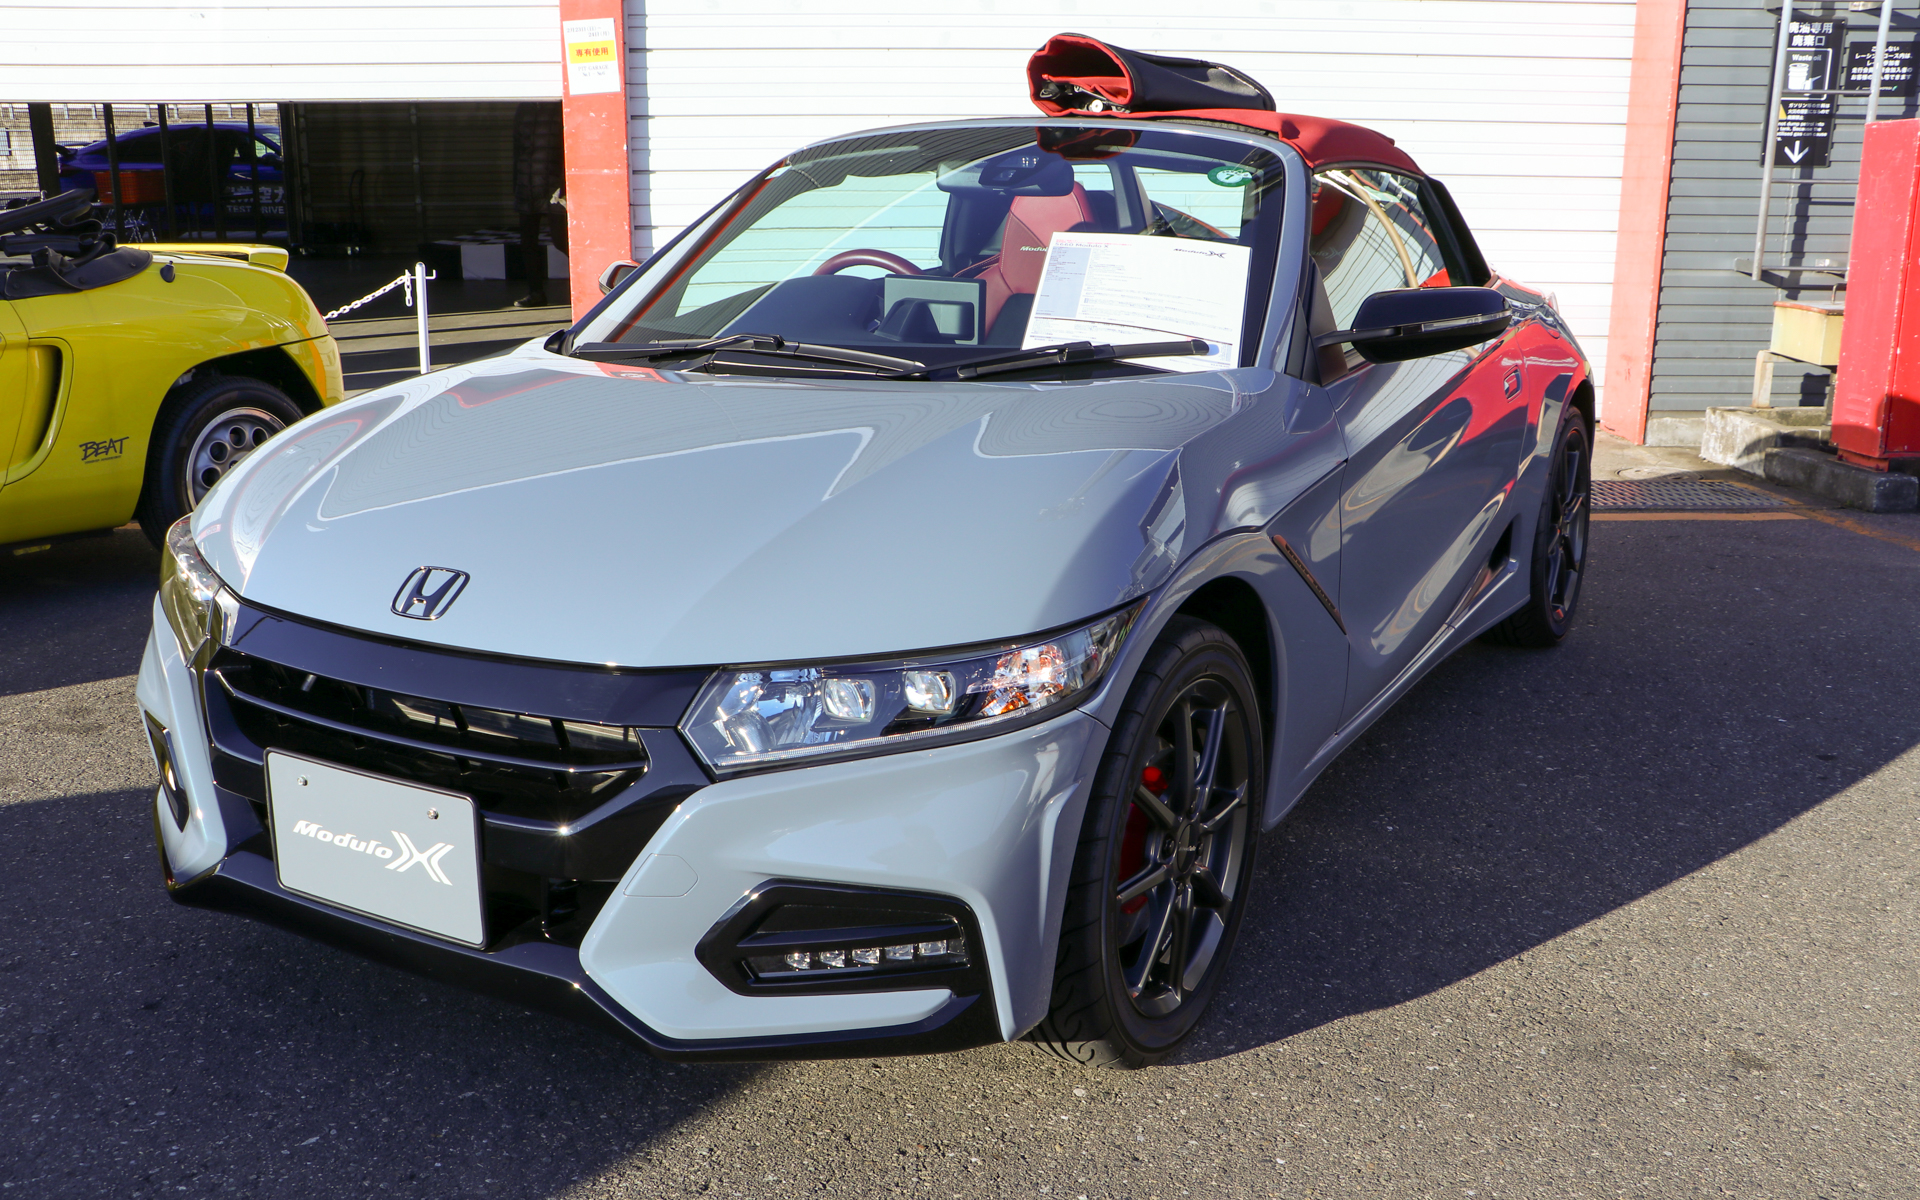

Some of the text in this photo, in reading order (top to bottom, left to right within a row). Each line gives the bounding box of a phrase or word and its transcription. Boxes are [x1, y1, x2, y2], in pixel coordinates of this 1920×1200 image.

[1788, 22, 1833, 34] 廃油専用
[1792, 35, 1826, 47] 廃棄口
[575, 46, 609, 57] 専有使用
[226, 205, 285, 214] TEST RIVE
[79, 436, 129, 461] BEAT
[293, 819, 394, 859] Modulo
